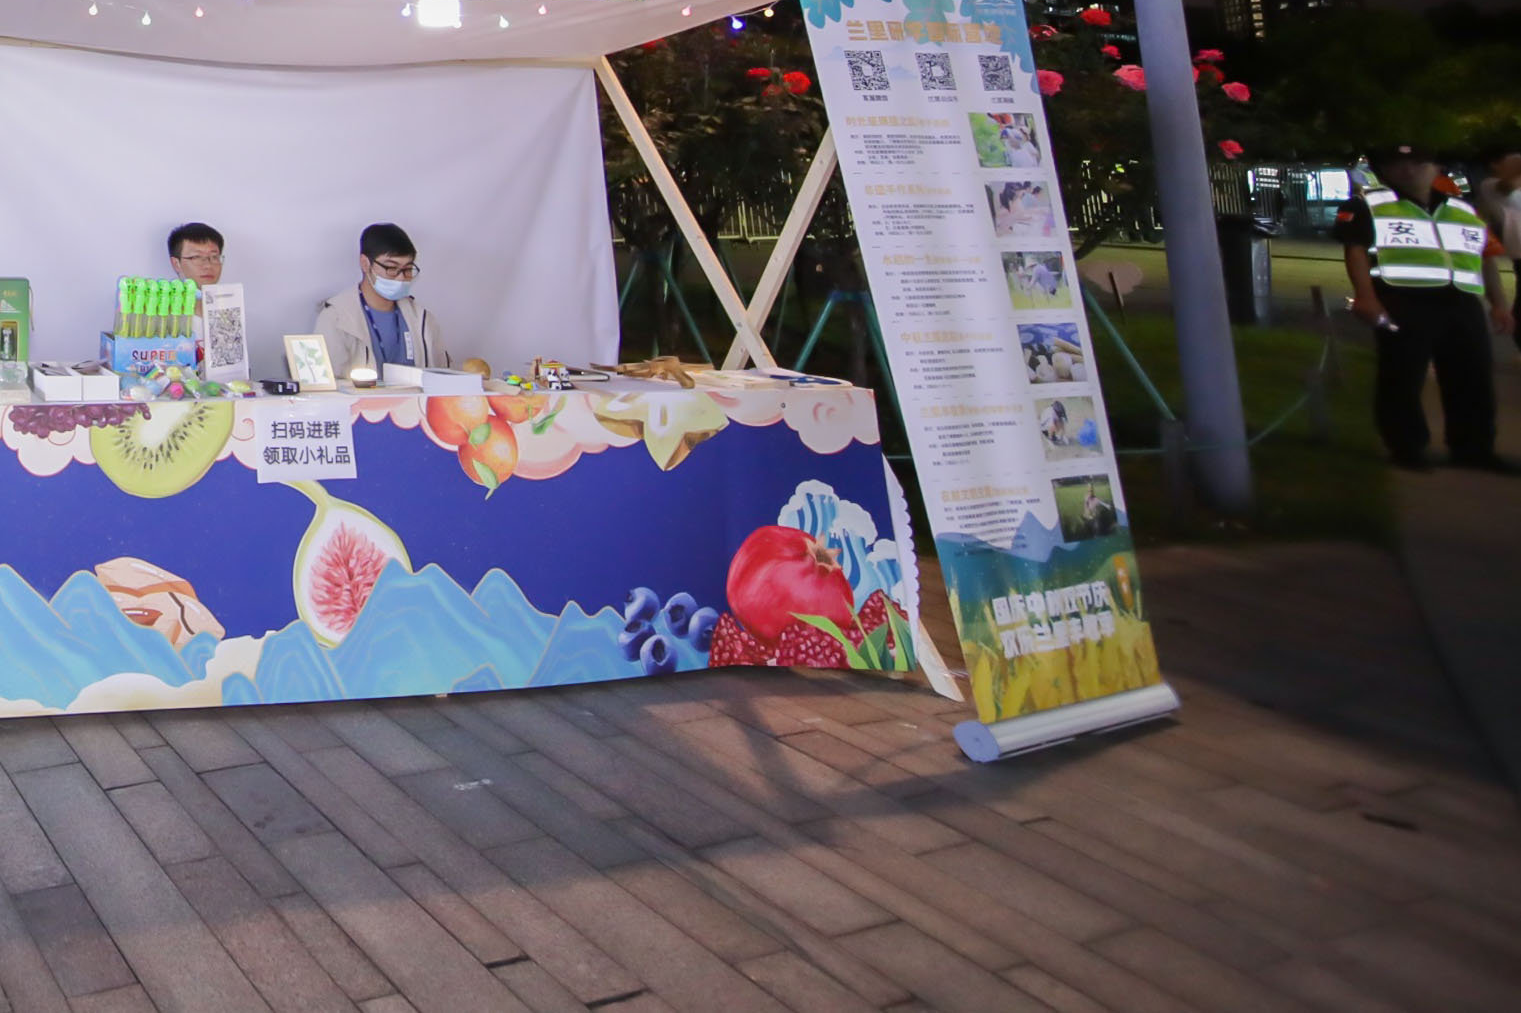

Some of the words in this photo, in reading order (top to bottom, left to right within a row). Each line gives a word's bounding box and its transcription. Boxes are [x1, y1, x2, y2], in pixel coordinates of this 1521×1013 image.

[1388, 221, 1415, 235] 安
[1461, 228, 1481, 243] 保
[132, 350, 177, 361] SUPER
[272, 421, 341, 439] 扫码进群
[263, 445, 351, 465] 领取小礼品
